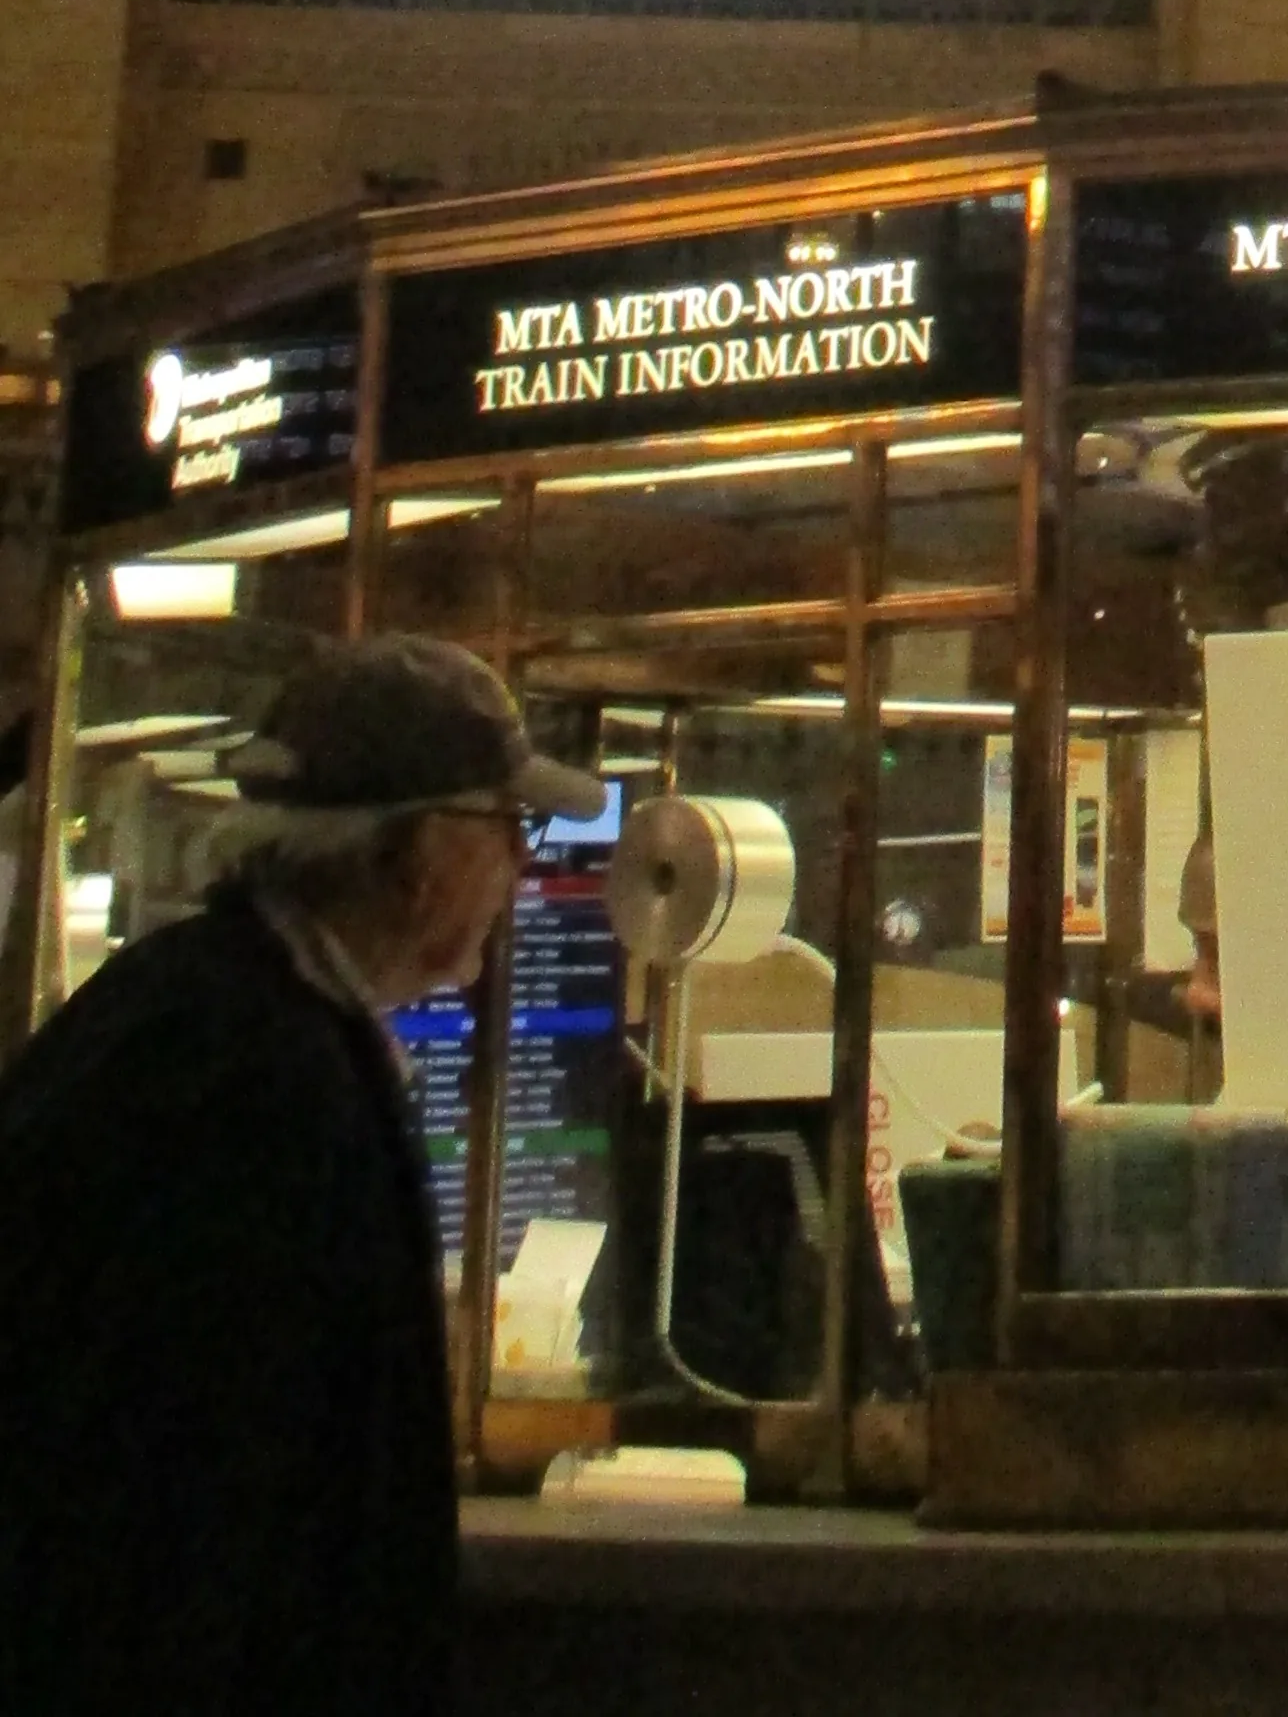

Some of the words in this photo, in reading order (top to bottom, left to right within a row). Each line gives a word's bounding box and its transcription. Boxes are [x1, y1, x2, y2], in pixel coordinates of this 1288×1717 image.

[496, 304, 584, 355] MTA
[594, 260, 918, 340] METRO-NORTH
[477, 356, 606, 413] TRAIN
[615, 315, 933, 395] INFORMATION
[866, 1093, 896, 1230] CLOSE
